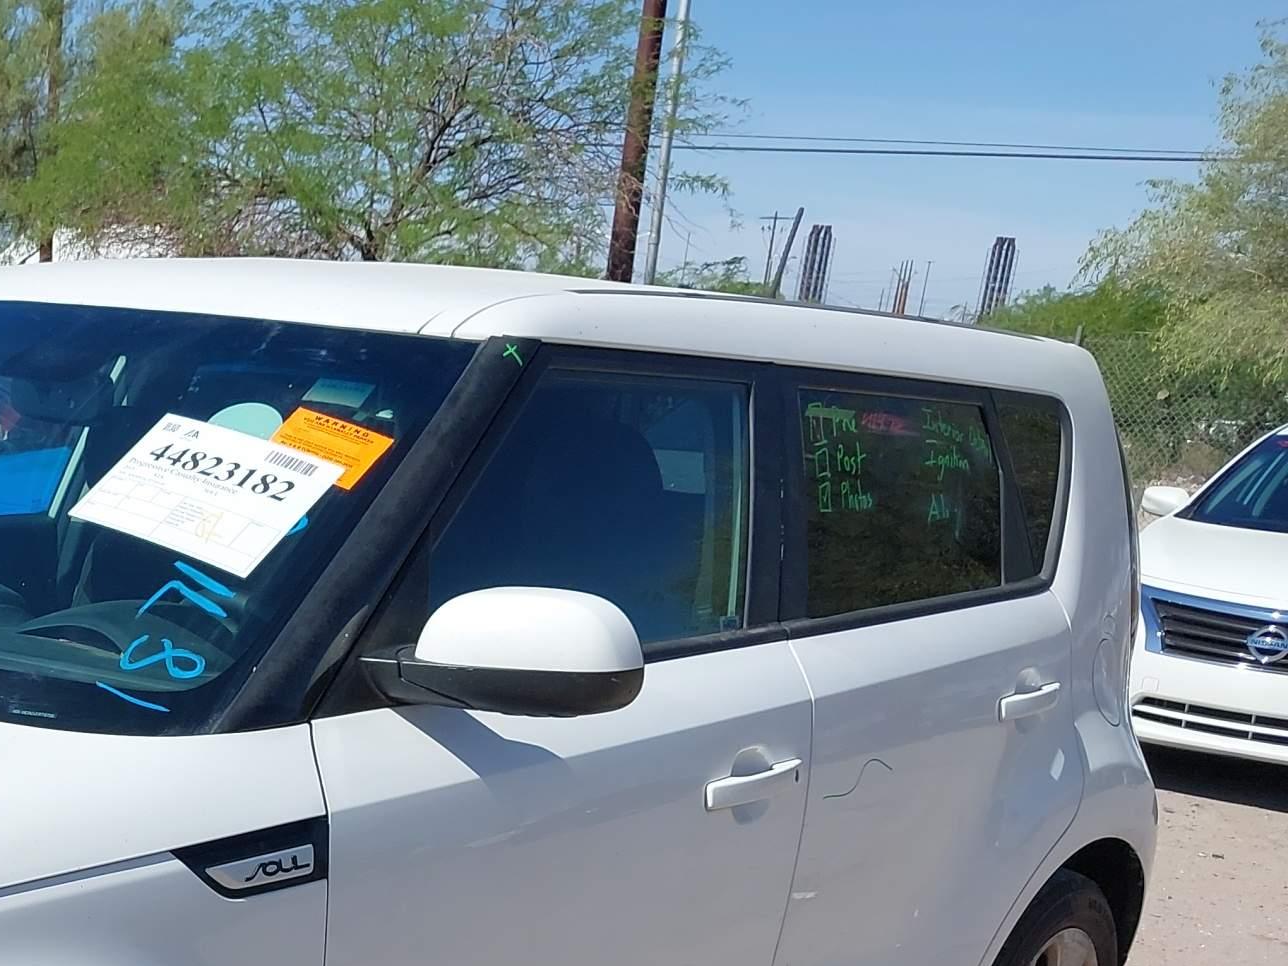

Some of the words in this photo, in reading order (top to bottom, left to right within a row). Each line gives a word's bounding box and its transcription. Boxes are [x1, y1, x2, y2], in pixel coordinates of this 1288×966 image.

[149, 443, 295, 502] 44823182
[837, 441, 867, 475] Post
[244, 855, 311, 882] SOUL
